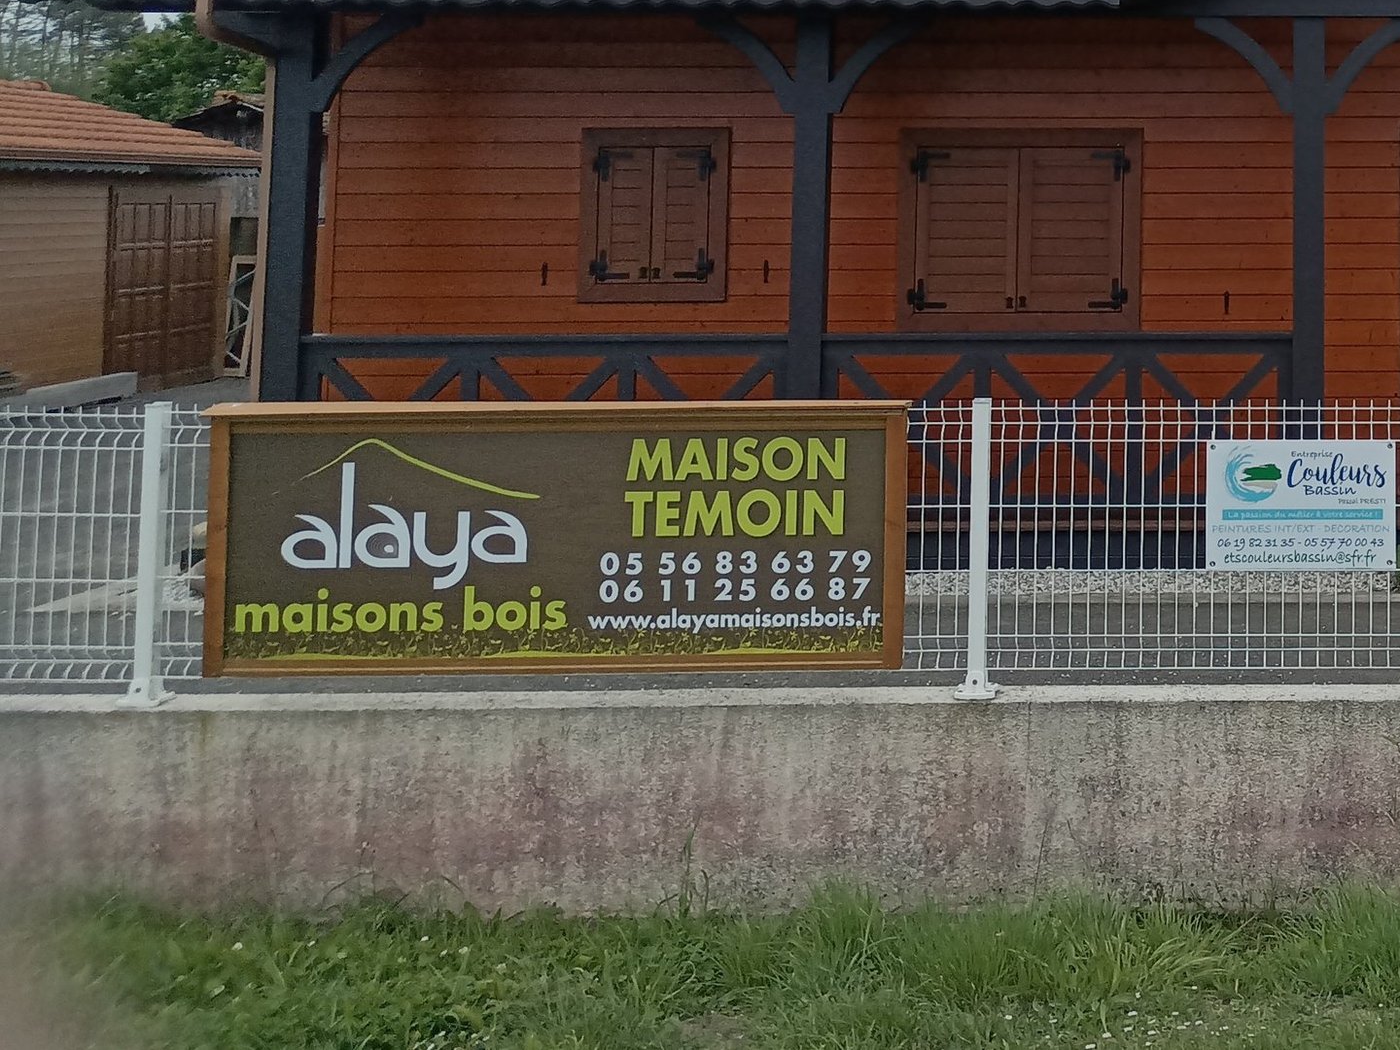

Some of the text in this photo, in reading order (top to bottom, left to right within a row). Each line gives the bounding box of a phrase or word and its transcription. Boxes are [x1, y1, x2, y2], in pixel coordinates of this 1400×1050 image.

[626, 436, 846, 481] MAISON
[1290, 449, 1333, 460] Entreprise
[1287, 453, 1387, 488] Couleurs
[1302, 482, 1357, 496] Bassin
[280, 462, 528, 590] alaya
[624, 489, 845, 537] TEMOIN
[1212, 524, 1272, 534] PEINTURES
[1274, 524, 1314, 534] INT/EXT
[1217, 537, 1231, 547] 06
[1234, 538, 1246, 551] 19
[1248, 538, 1262, 547] 82
[1265, 538, 1278, 547] 31
[1280, 538, 1296, 547] 35
[1304, 538, 1318, 547] 05
[1320, 538, 1336, 549] 57
[1337, 538, 1352, 549] 70
[1354, 538, 1367, 547] 00
[1370, 538, 1384, 547] 43
[1224, 548, 1377, 567] etscouleursbassin@sfr.fr
[599, 549, 872, 576] 05 56 83 63 79
[599, 577, 871, 603] 06 11 25 66 87
[235, 585, 567, 633] maisons bois
[588, 606, 881, 634] www.alayamaisonsbois.fr
